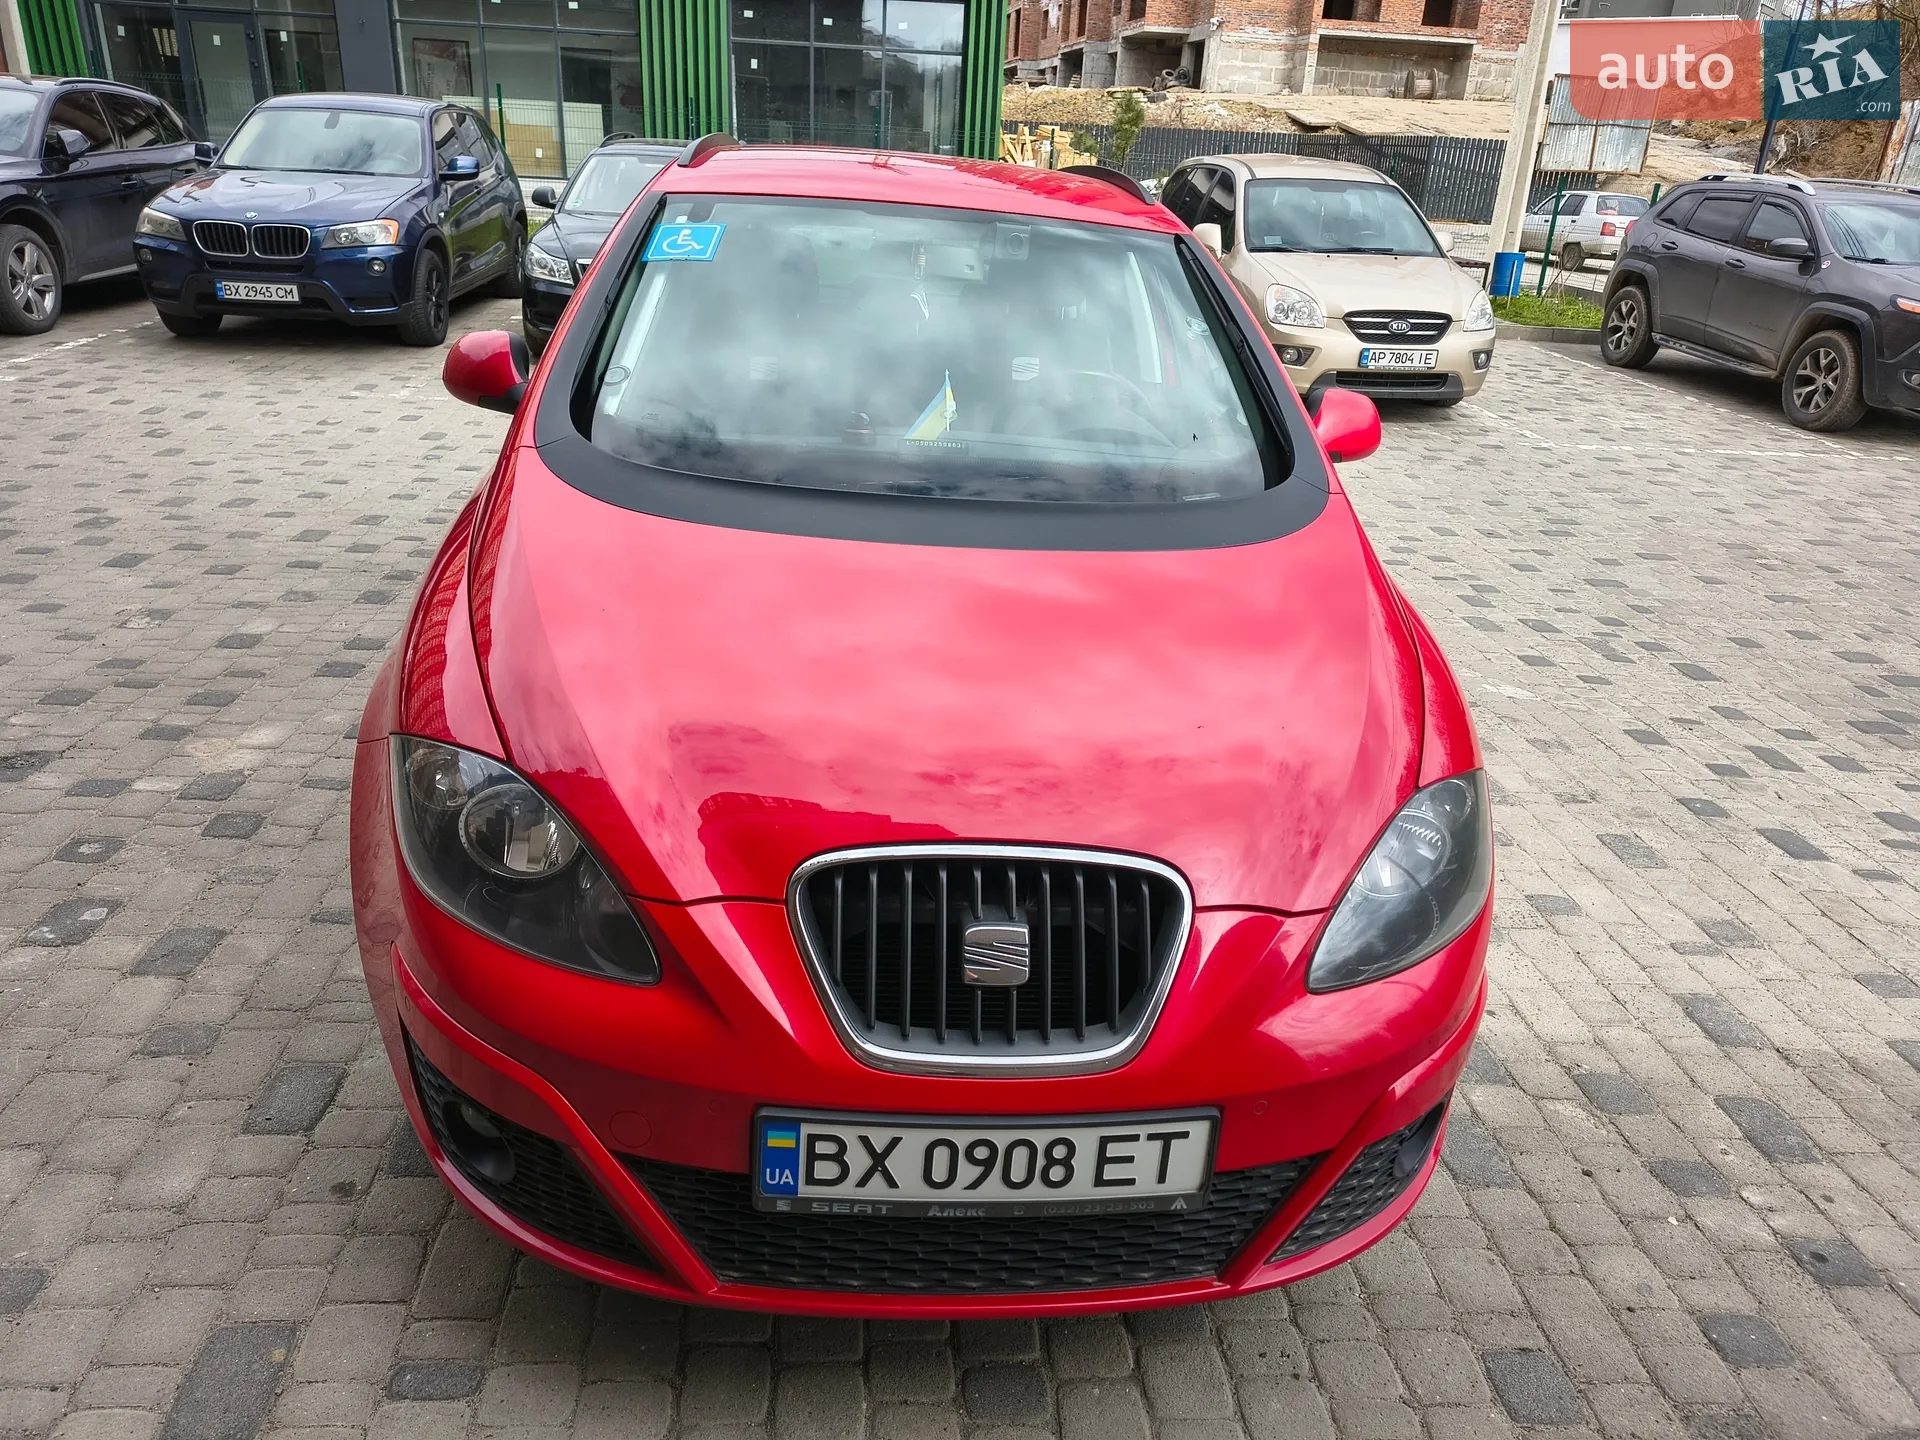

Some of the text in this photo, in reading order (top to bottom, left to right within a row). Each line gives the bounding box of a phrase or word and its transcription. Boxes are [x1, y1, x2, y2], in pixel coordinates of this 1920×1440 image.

[223, 284, 295, 300] BX 2945 CM
[1392, 322, 1407, 330] KIA
[1368, 351, 1434, 365] AP 7804 IE
[804, 1130, 1191, 1191] BX 0908 ET
[766, 1167, 794, 1186] UA
[811, 1202, 894, 1215] SEAT
[927, 1205, 987, 1217] Алекс
